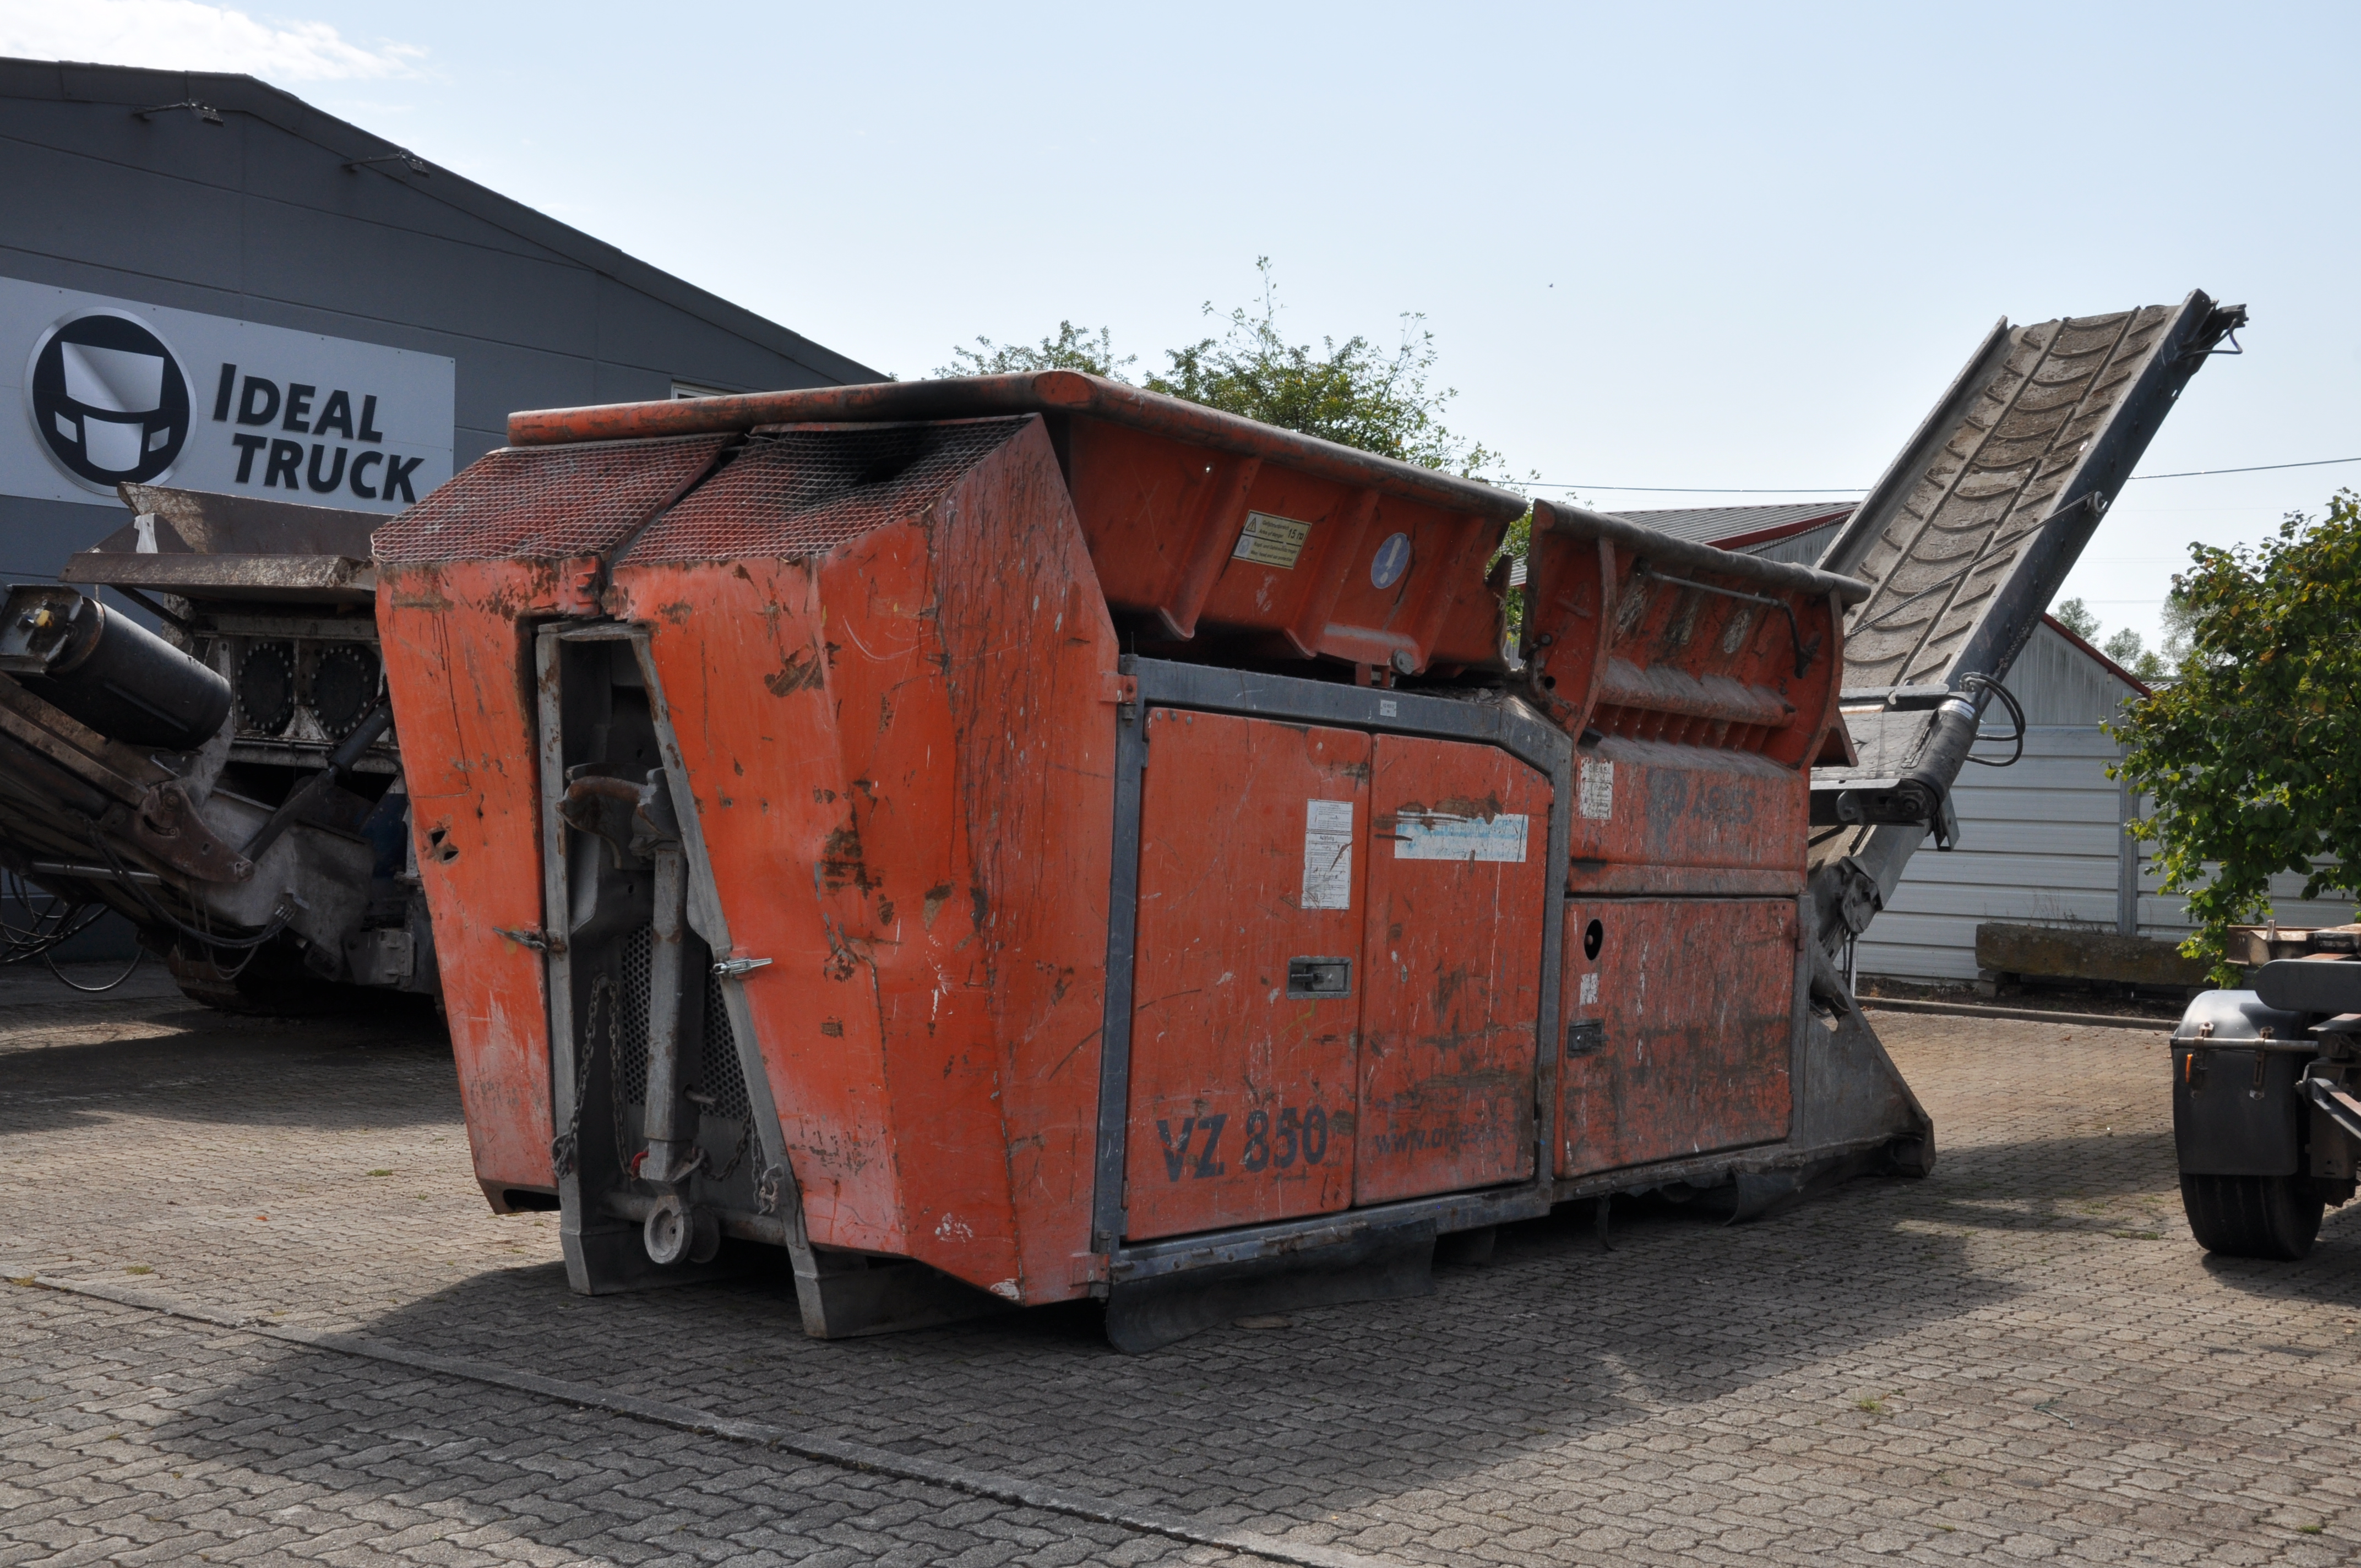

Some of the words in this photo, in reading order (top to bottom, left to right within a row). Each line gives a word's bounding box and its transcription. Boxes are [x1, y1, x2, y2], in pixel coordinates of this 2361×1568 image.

[214, 363, 384, 443] IDEAL
[232, 433, 425, 504] TRUCK
[1288, 529, 1297, 538] 15
[1157, 1113, 1227, 1182] VZ
[1243, 1104, 1328, 1173] 850
